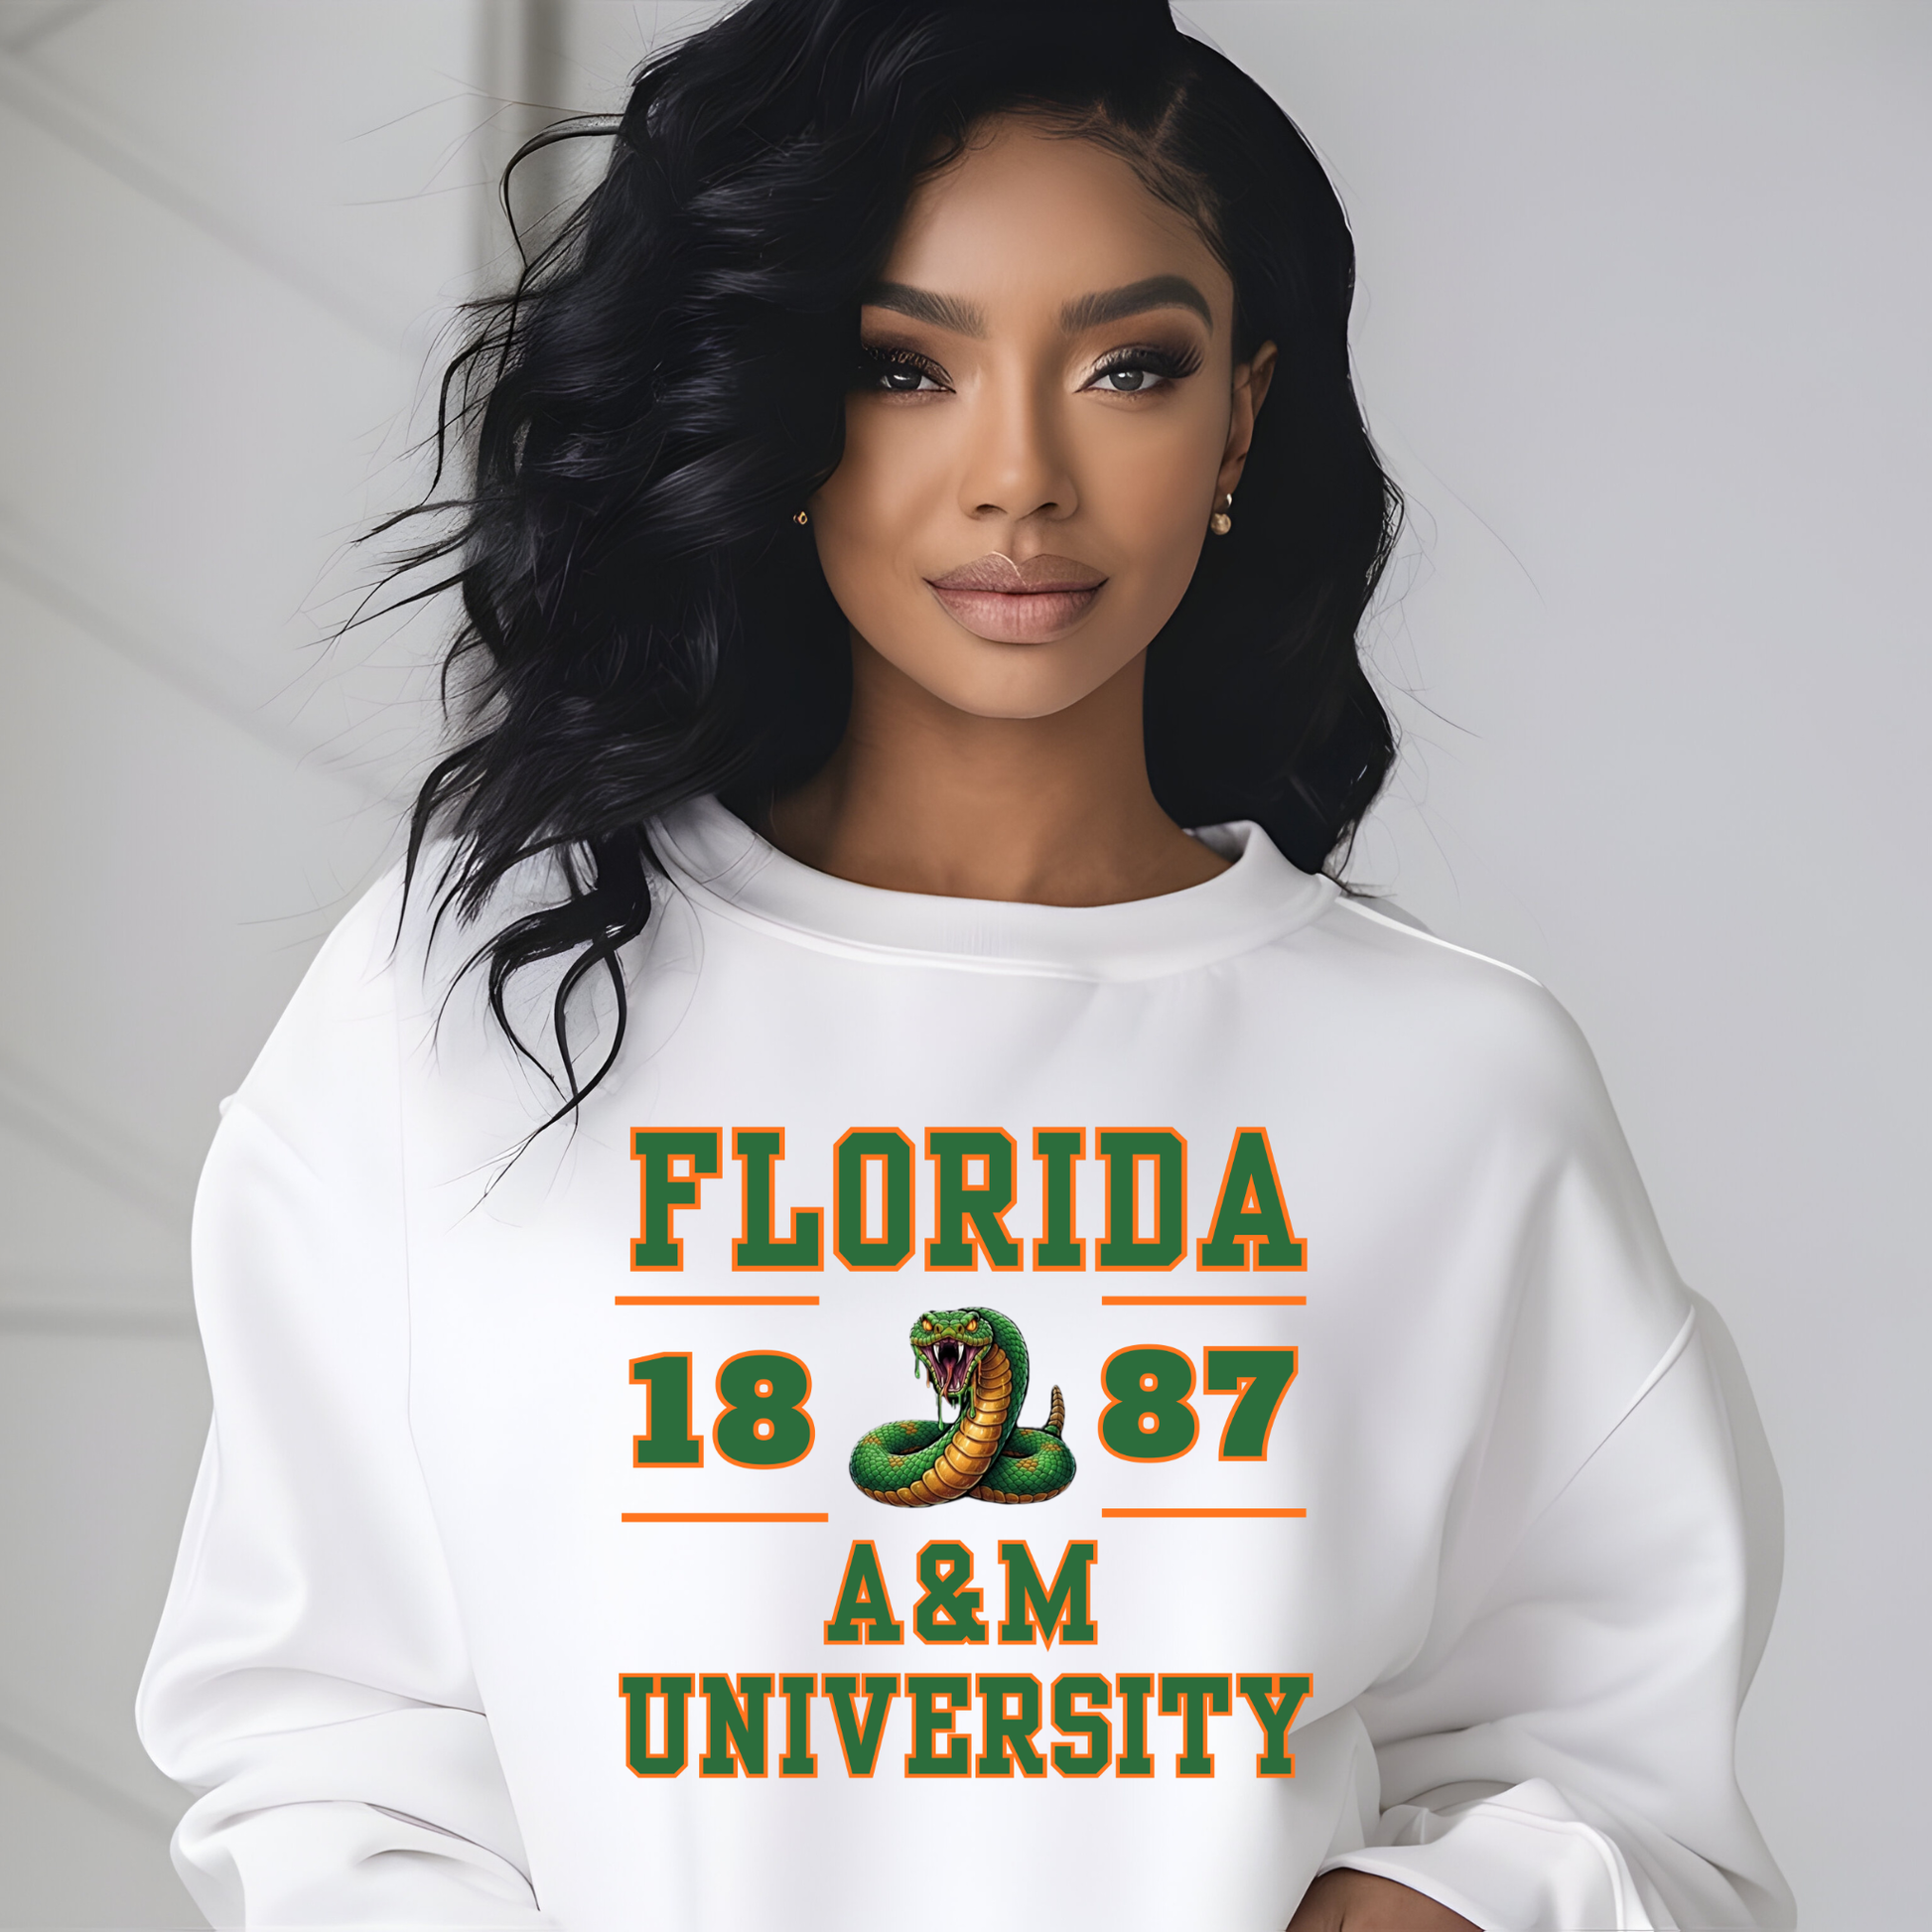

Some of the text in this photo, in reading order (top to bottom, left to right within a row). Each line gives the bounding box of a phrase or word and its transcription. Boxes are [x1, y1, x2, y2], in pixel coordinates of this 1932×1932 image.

[630, 1127, 1308, 1272] FLORIDA
[629, 1344, 1299, 1469] 18 87
[824, 1540, 1098, 1651] A&M
[619, 1673, 1313, 1778] UNIVERSITY
